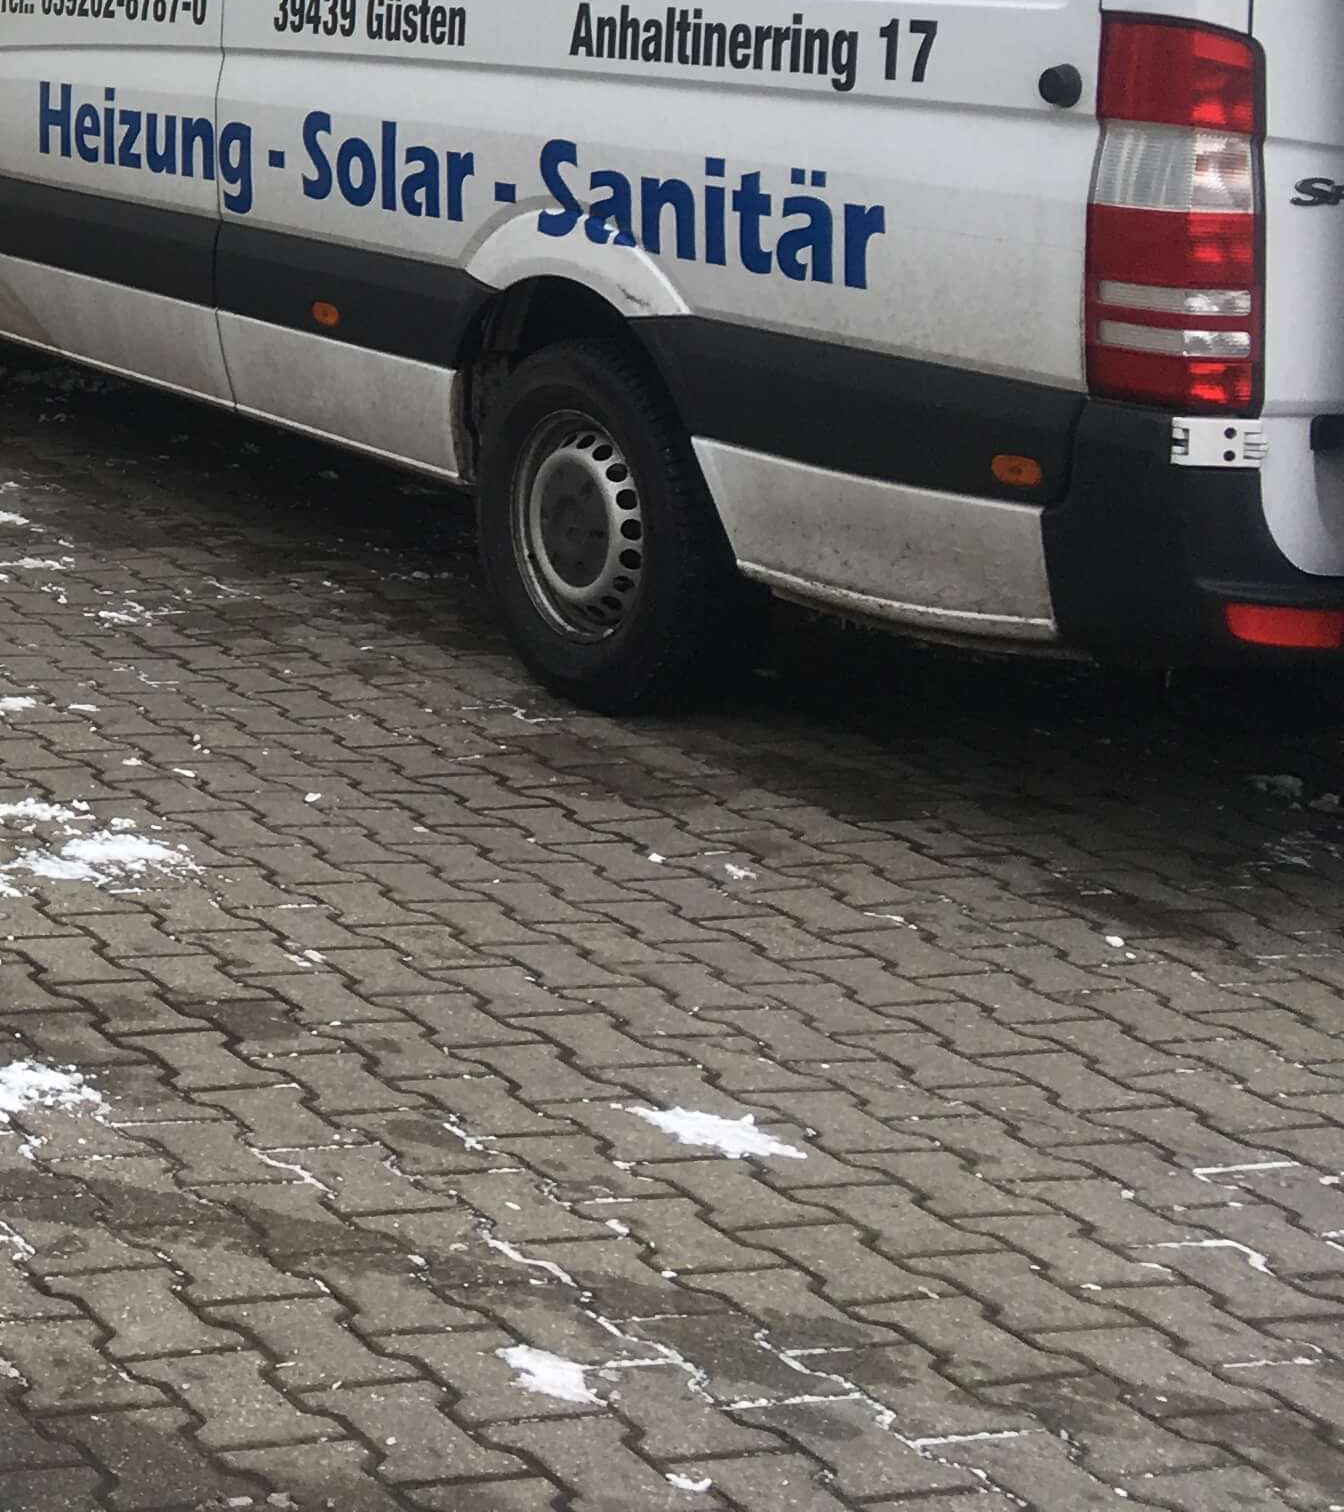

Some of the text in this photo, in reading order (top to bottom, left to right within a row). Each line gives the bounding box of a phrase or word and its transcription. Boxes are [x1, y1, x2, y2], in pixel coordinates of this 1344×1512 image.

[568, 1, 939, 92] Anhaltinerring 17
[38, 80, 254, 215] Heizung
[301, 110, 476, 223] Solar
[536, 138, 886, 290] Sanitär
